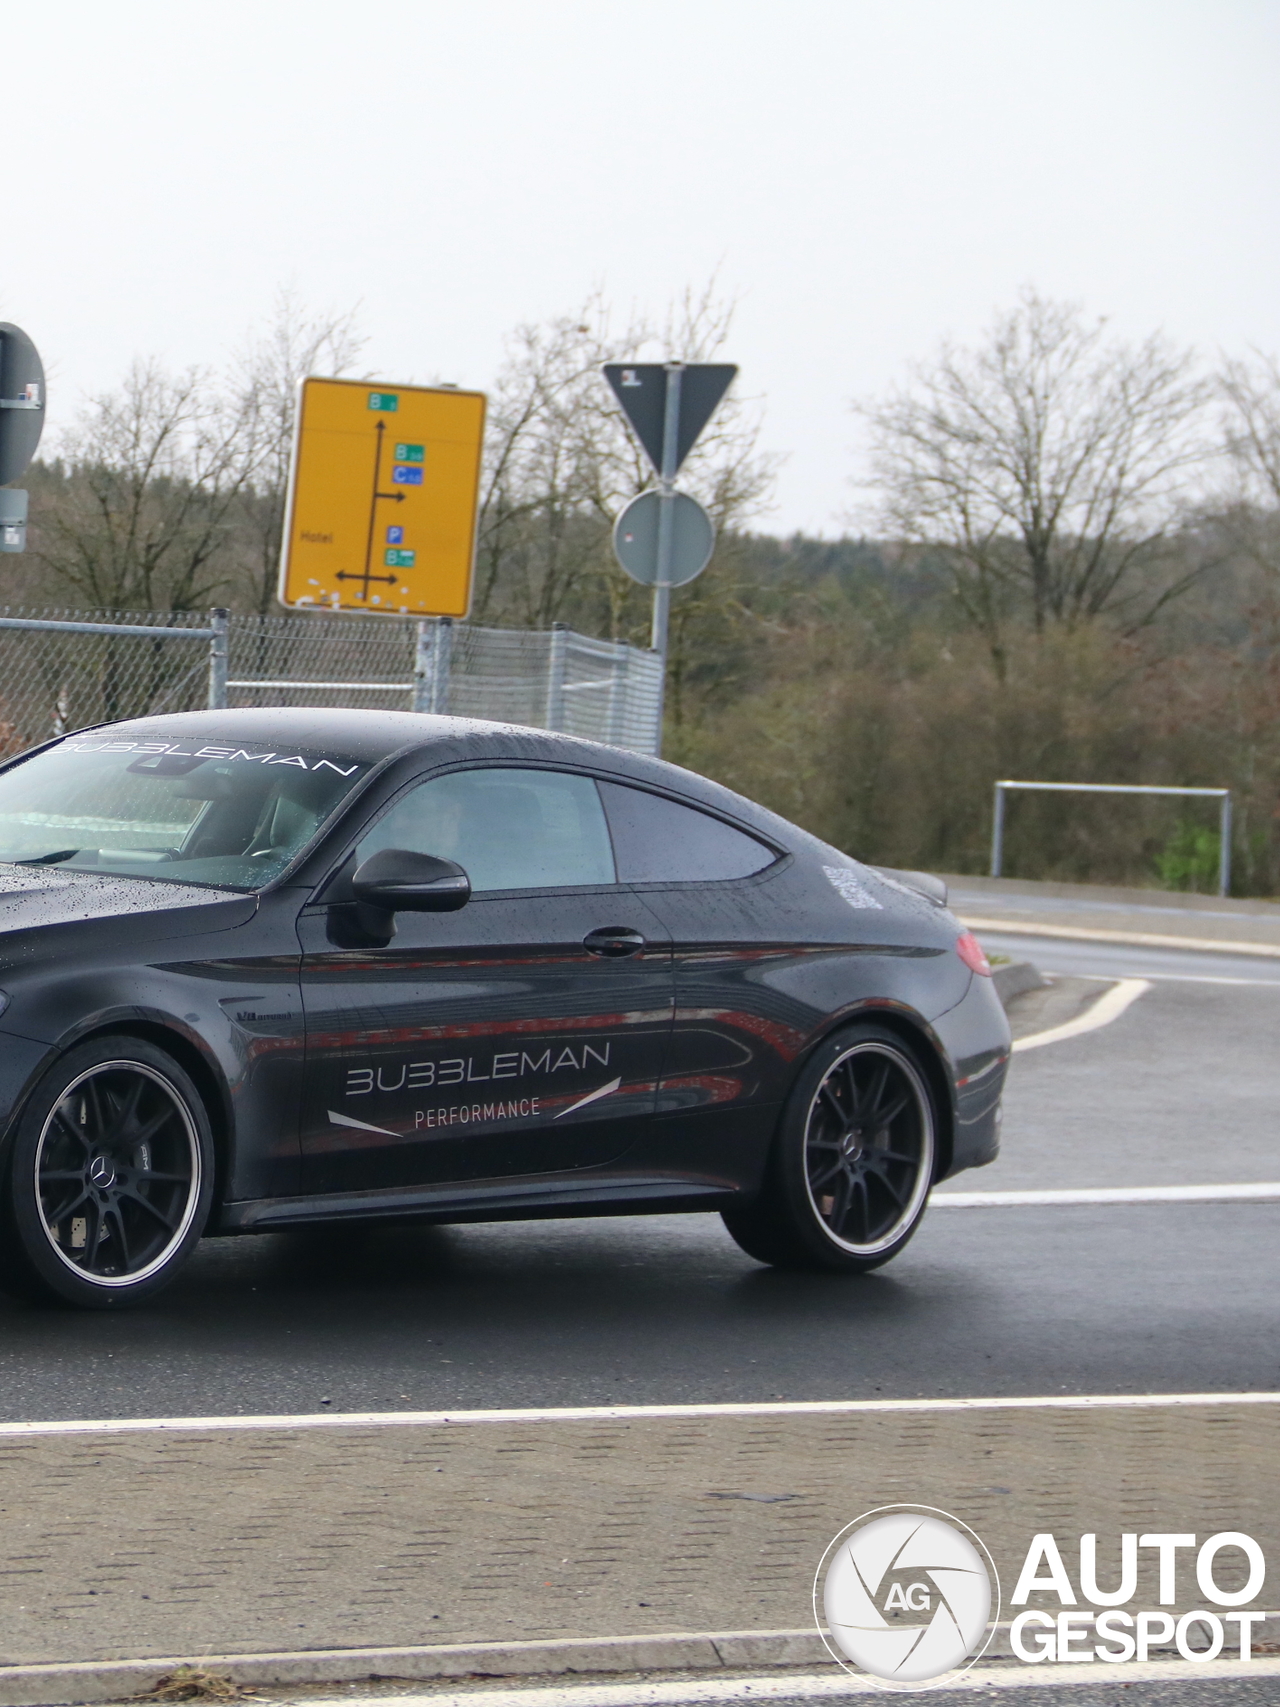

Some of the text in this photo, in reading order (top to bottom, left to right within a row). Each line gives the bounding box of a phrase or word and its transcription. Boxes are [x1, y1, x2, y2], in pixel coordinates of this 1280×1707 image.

[370, 393, 381, 408] B
[396, 444, 407, 459] B
[394, 466, 406, 482] C
[300, 530, 333, 544] Hotel
[389, 527, 400, 542] P
[345, 1041, 611, 1096] BUBBLEMAN
[414, 1097, 541, 1129] PERFORMANCE
